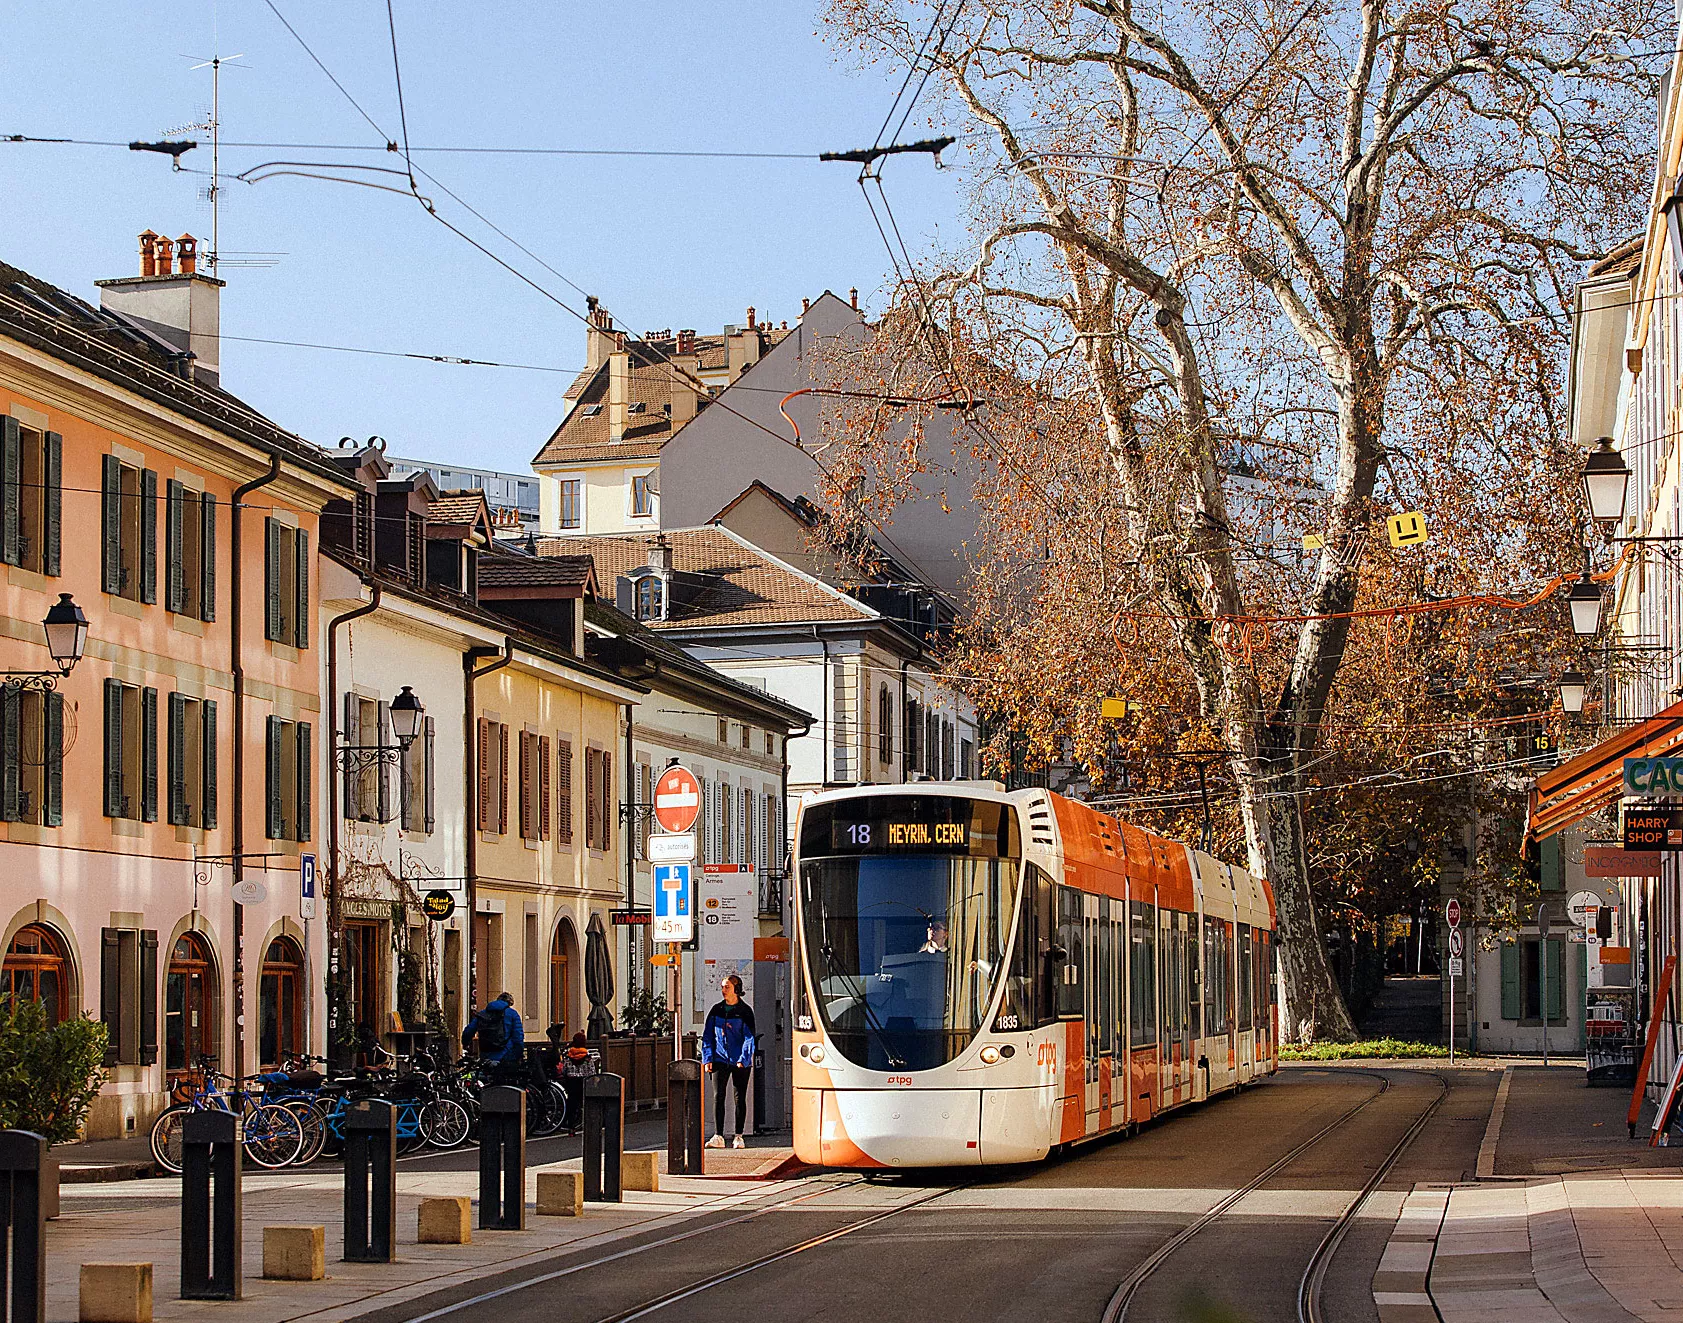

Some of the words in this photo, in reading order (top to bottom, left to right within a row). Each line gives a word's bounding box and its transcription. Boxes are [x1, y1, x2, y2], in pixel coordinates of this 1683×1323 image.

[1535, 737, 1548, 749] 15
[1627, 818, 1669, 828] HARRY
[847, 824, 870, 844] 18
[889, 823, 931, 844] MEYRIN,
[935, 823, 964, 844] CERN
[1628, 832, 1663, 843] SHOP
[305, 862, 312, 893] P
[1449, 909, 1458, 918] STOP
[661, 920, 672, 933] 45
[999, 1015, 1017, 1029] 1835
[896, 1075, 912, 1086] tpg
